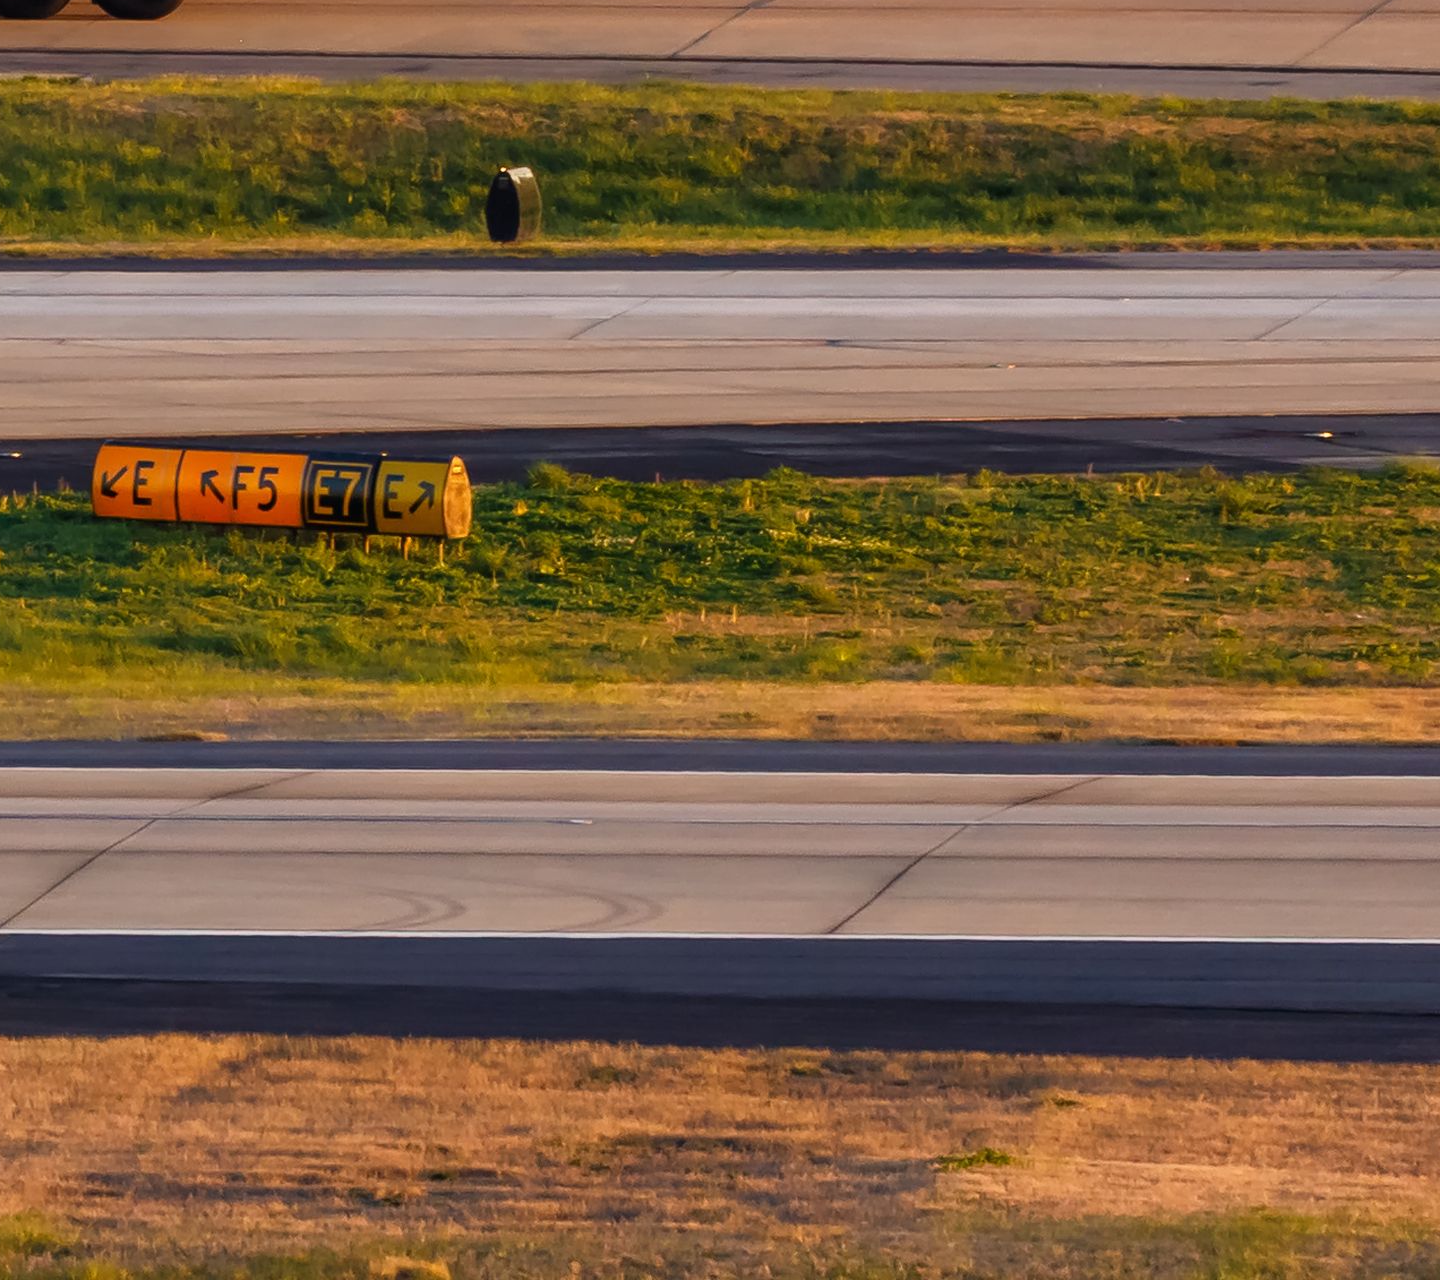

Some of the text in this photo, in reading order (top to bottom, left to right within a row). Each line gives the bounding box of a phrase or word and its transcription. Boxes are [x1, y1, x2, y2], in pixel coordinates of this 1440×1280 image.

[133, 460, 404, 519] E F5 E7 E
